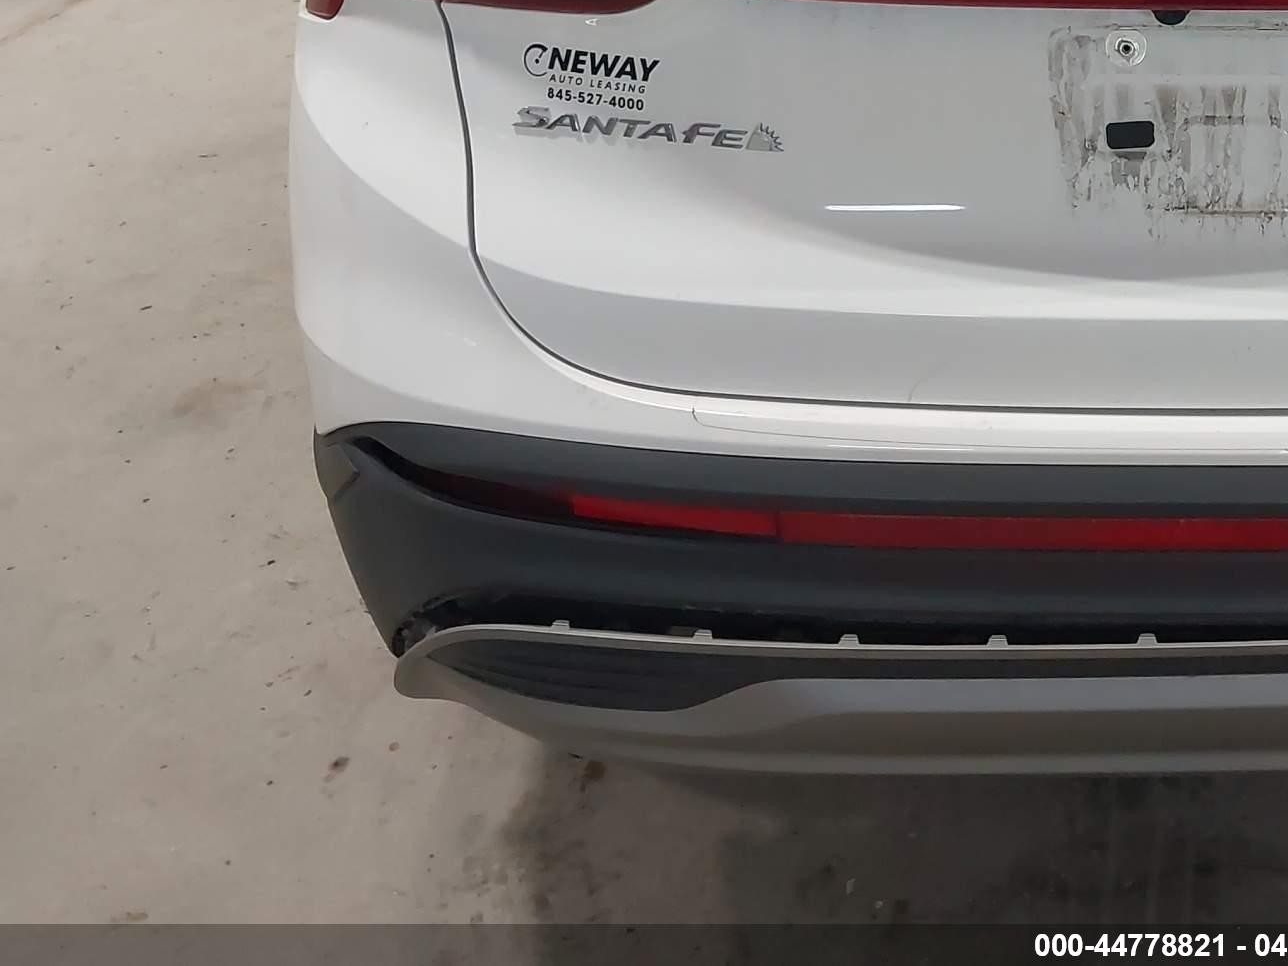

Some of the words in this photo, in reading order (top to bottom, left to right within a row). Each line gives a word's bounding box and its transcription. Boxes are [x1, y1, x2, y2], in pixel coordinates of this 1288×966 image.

[549, 73, 583, 86] AUTO
[590, 79, 646, 94] LEASING
[547, 87, 645, 111] 845-527-4000
[512, 106, 677, 143] SANTA
[682, 123, 748, 150] FE
